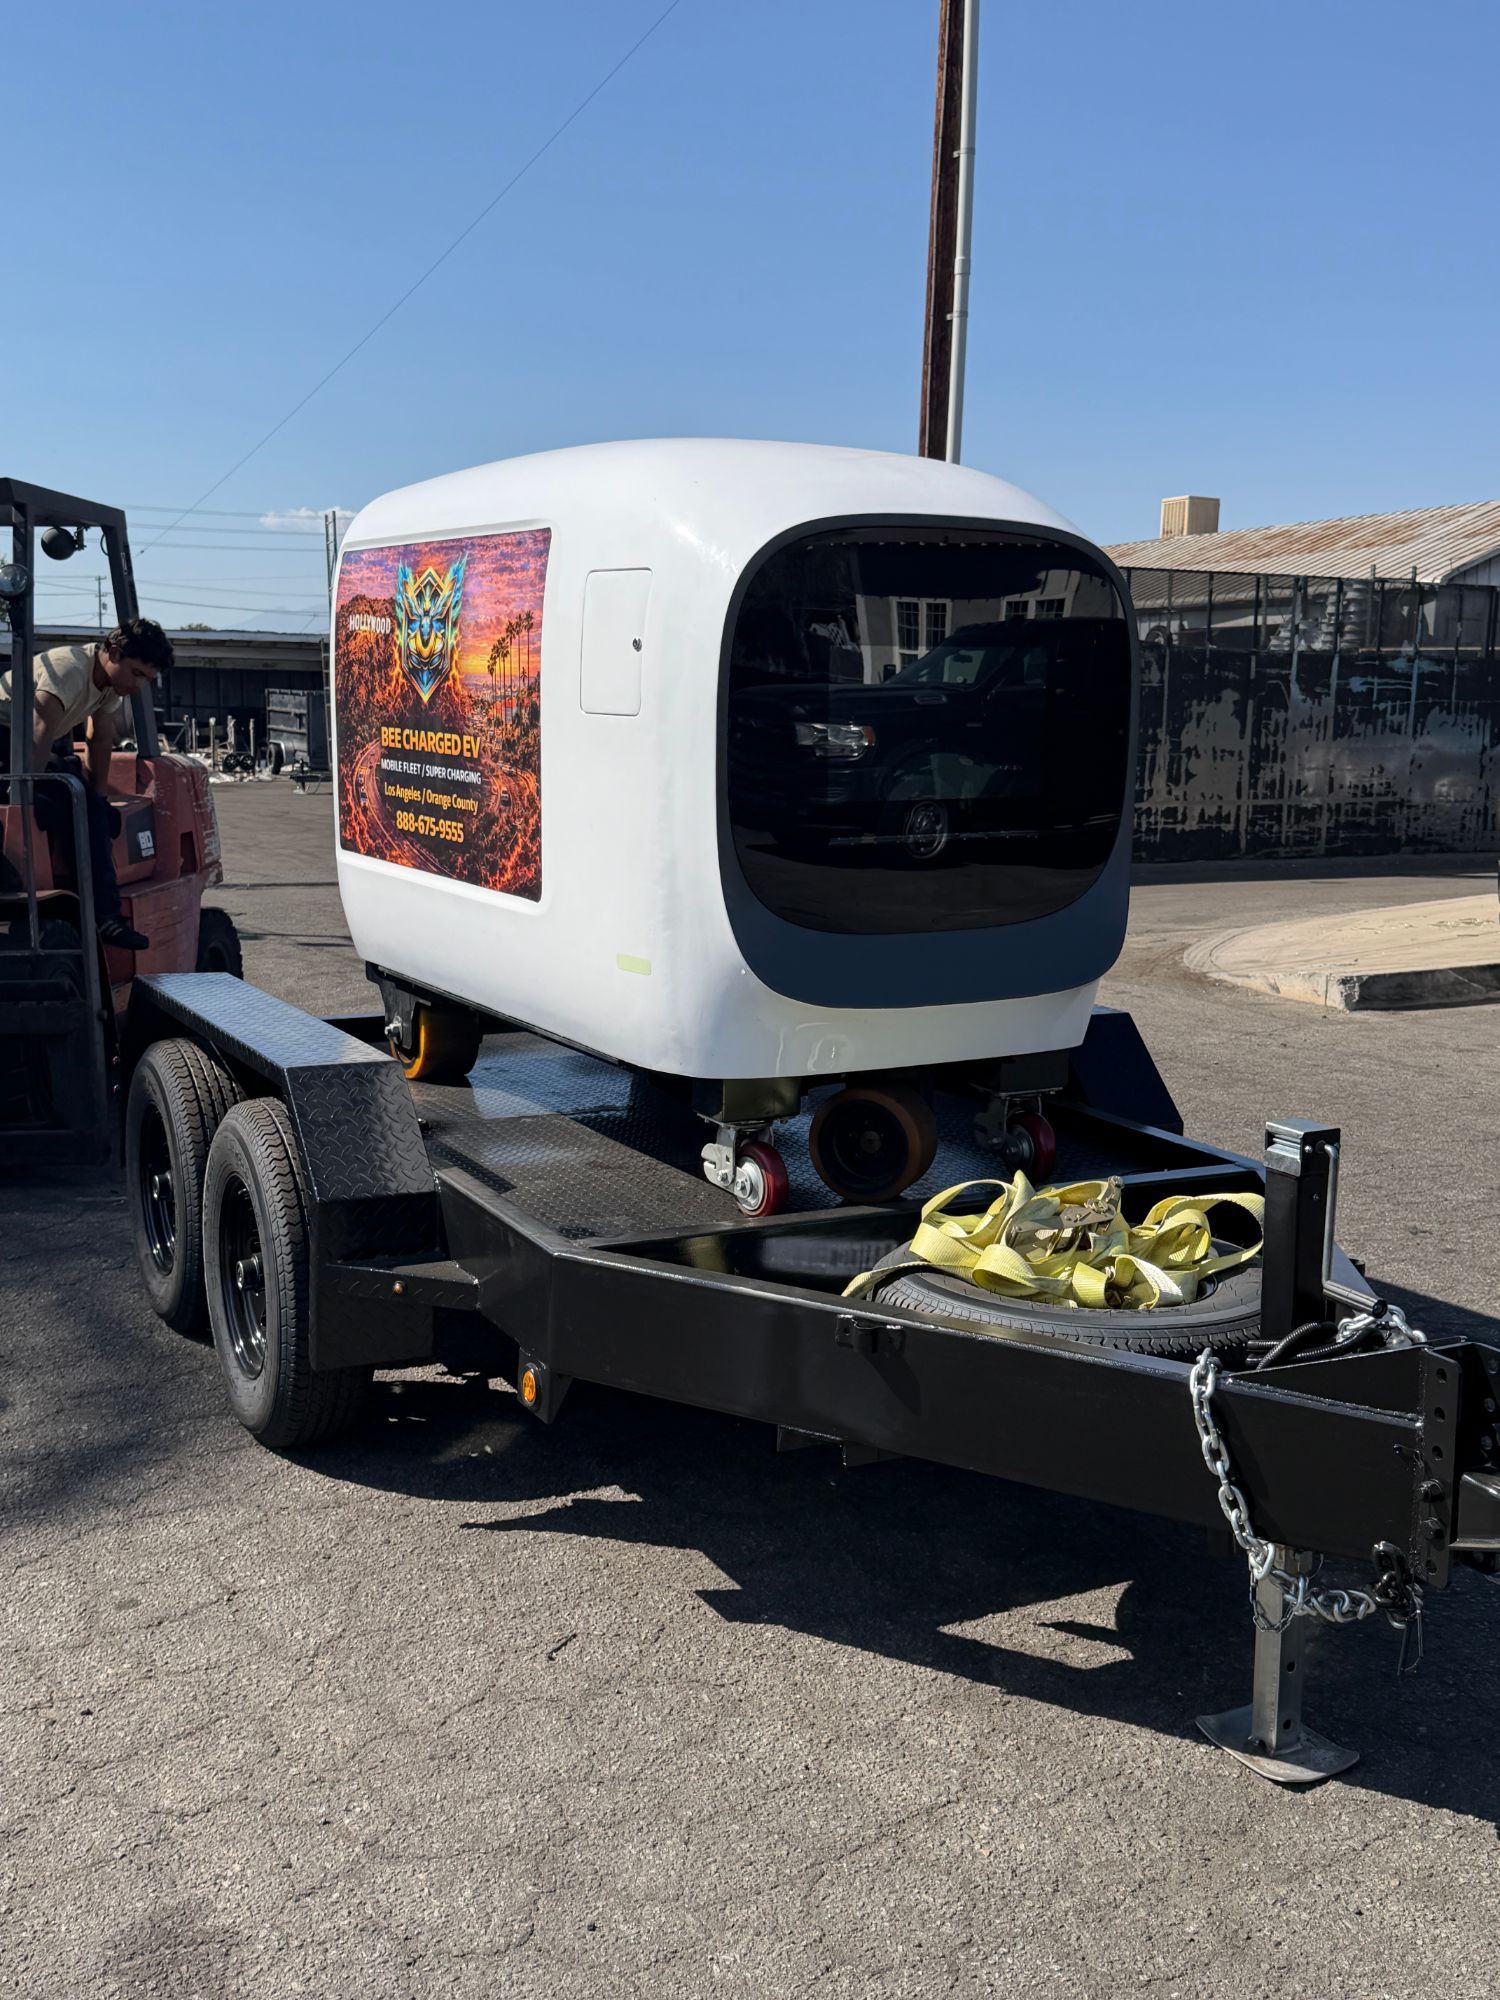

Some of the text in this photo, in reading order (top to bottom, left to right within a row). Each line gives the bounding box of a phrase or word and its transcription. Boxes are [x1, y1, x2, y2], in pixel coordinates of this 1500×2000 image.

[349, 614, 391, 634] HOLLYWOOD
[381, 726, 481, 759] BEE CHARGED EV
[381, 758, 402, 772] MOBILE
[403, 761, 421, 775] FLEET
[426, 765, 446, 779] SUPER
[447, 768, 481, 784] CHARGING
[384, 782, 478, 815] Los Angeles / Orange County
[396, 810, 464, 843] 888-675-9555
